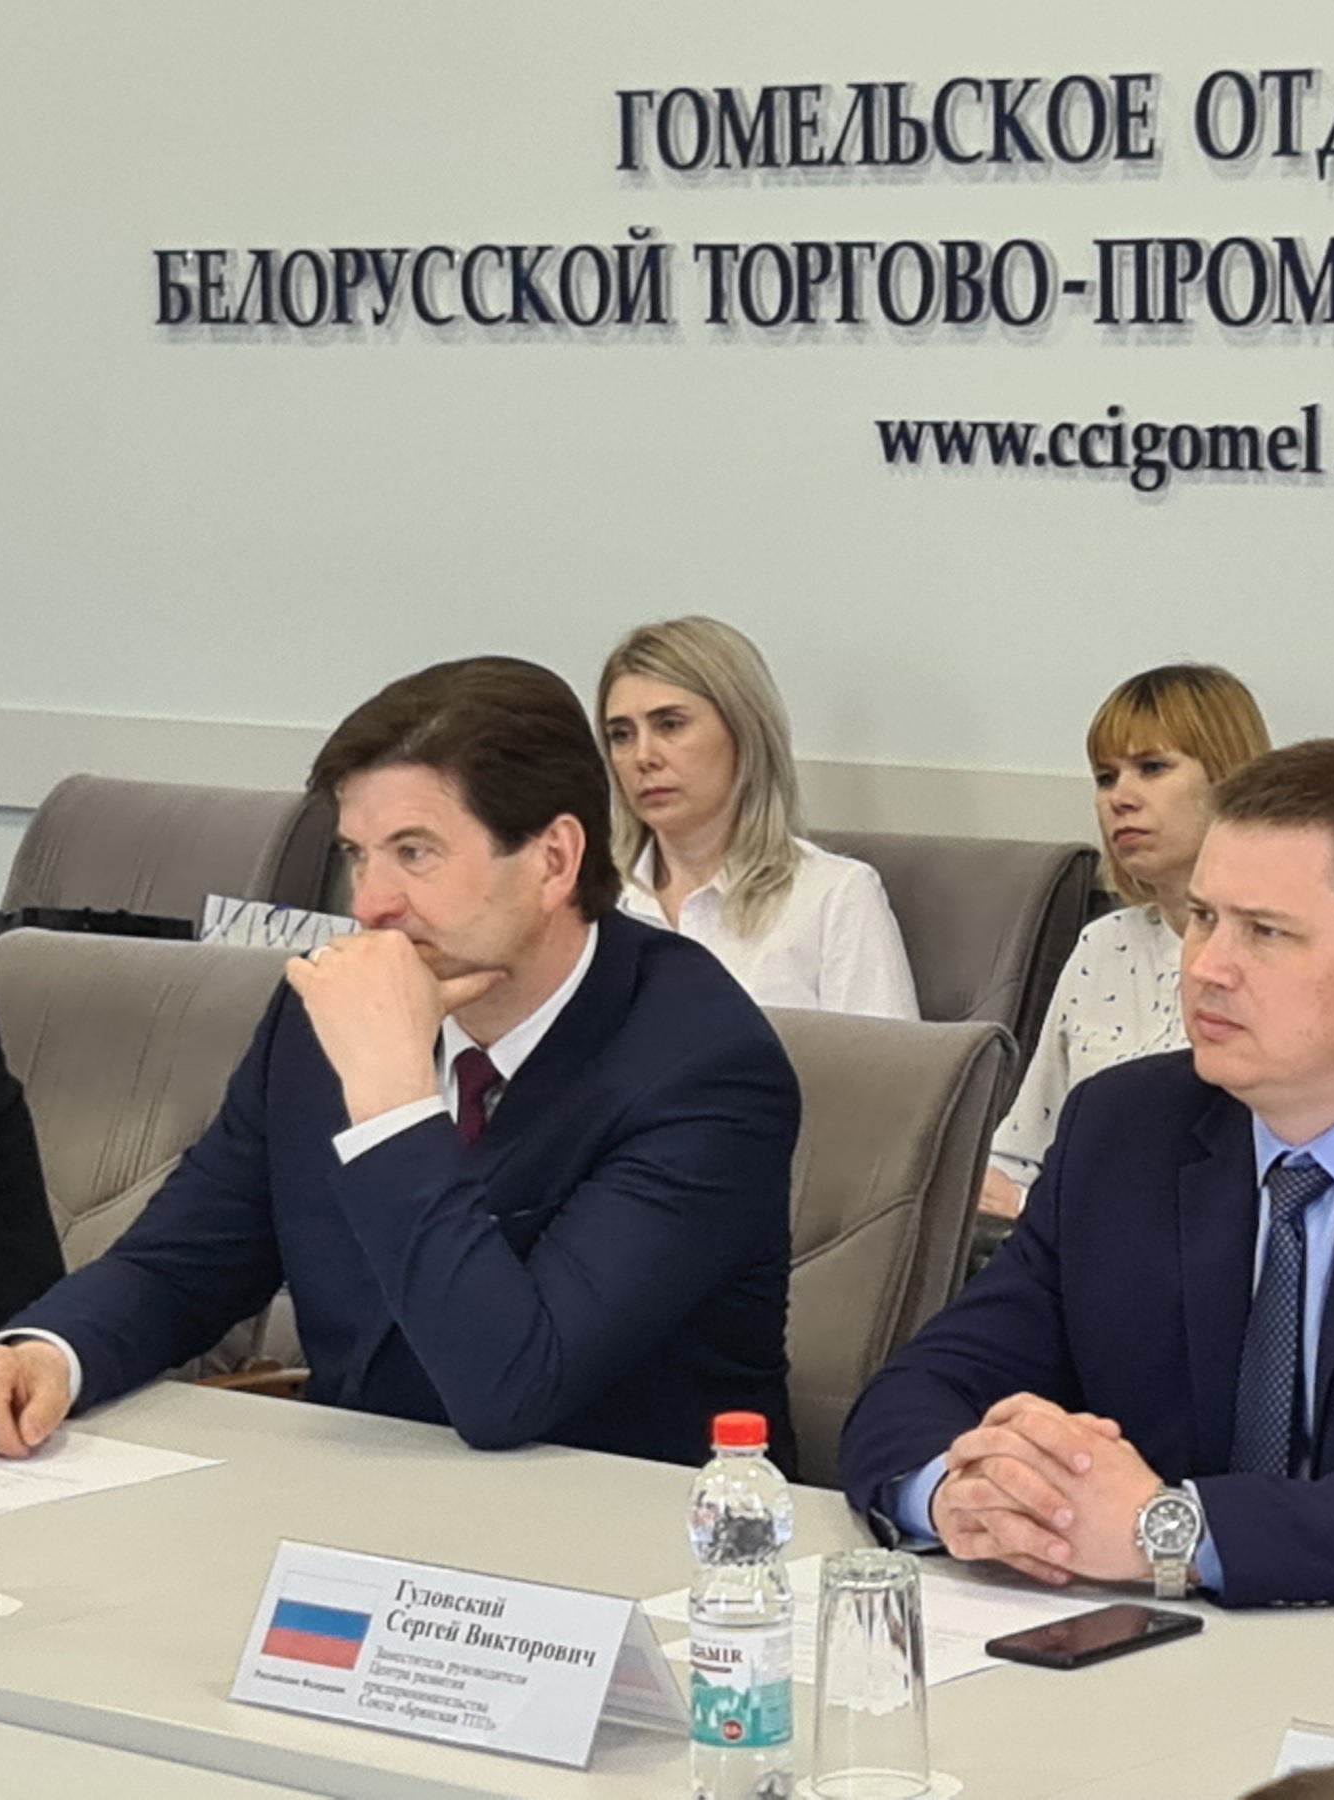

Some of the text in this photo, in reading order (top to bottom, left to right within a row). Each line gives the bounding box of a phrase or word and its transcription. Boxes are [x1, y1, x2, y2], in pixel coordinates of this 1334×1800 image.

[615, 73, 1157, 171] ГОМЕЛЬСКОЕ
[152, 226, 670, 327] БЕЛОРУССКОЙ
[394, 1578, 506, 1618] Гудовский
[386, 1608, 596, 1668] Сергей Викторович
